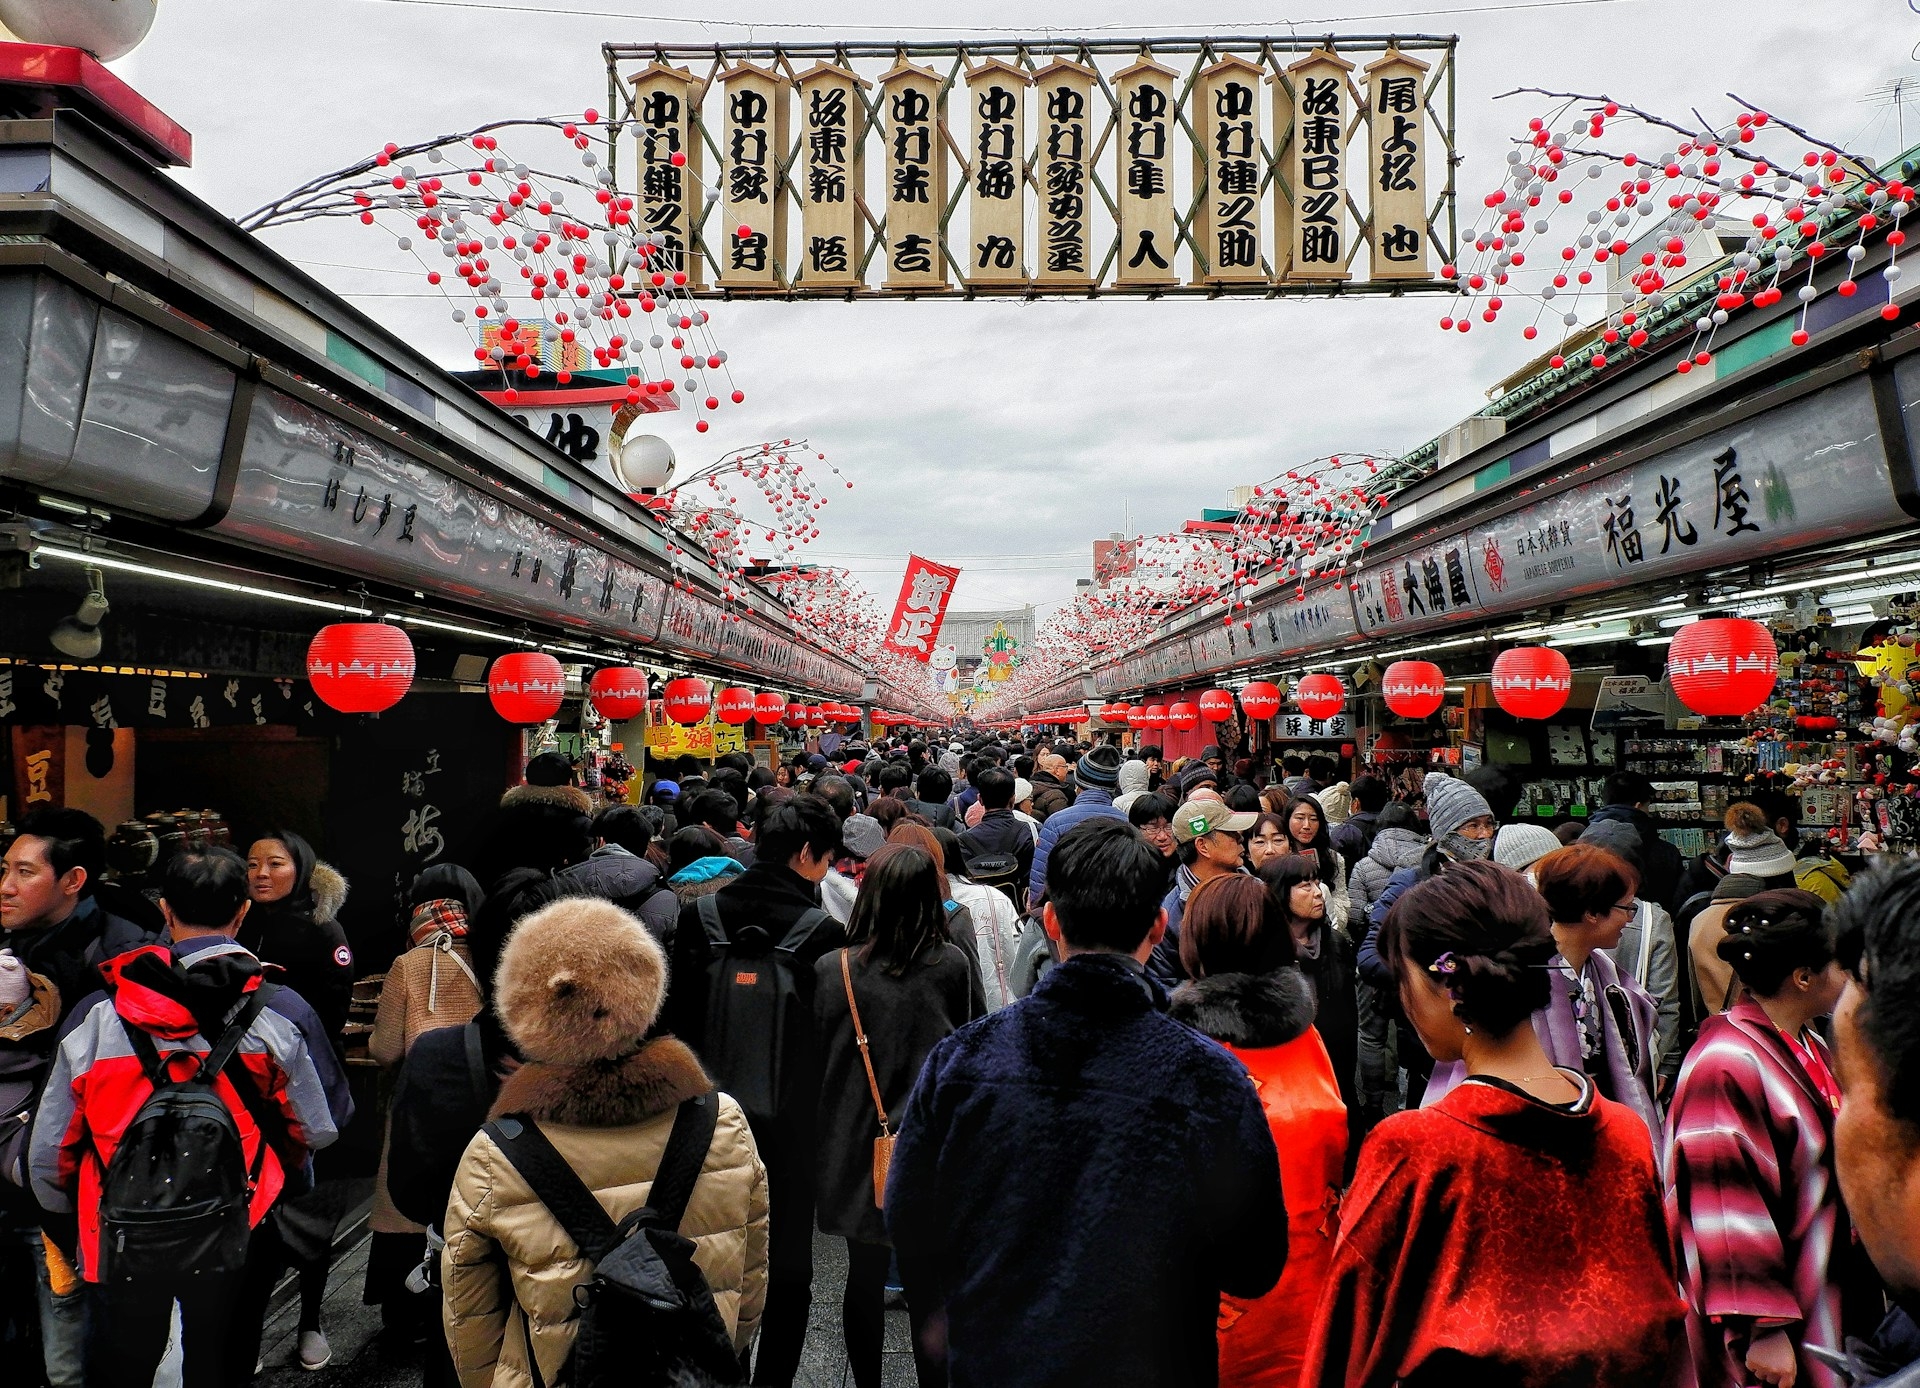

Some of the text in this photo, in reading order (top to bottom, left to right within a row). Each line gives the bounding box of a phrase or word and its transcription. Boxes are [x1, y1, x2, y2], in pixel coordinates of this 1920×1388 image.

[1377, 77, 1420, 262] 尾上松也
[1602, 446, 1760, 569] 福光屋
[1523, 555, 1576, 581] JAPANESE SOUVENIR
[894, 567, 951, 653] 賀正
[1285, 716, 1346, 737] 評判堂
[26, 750, 51, 802] 豆
